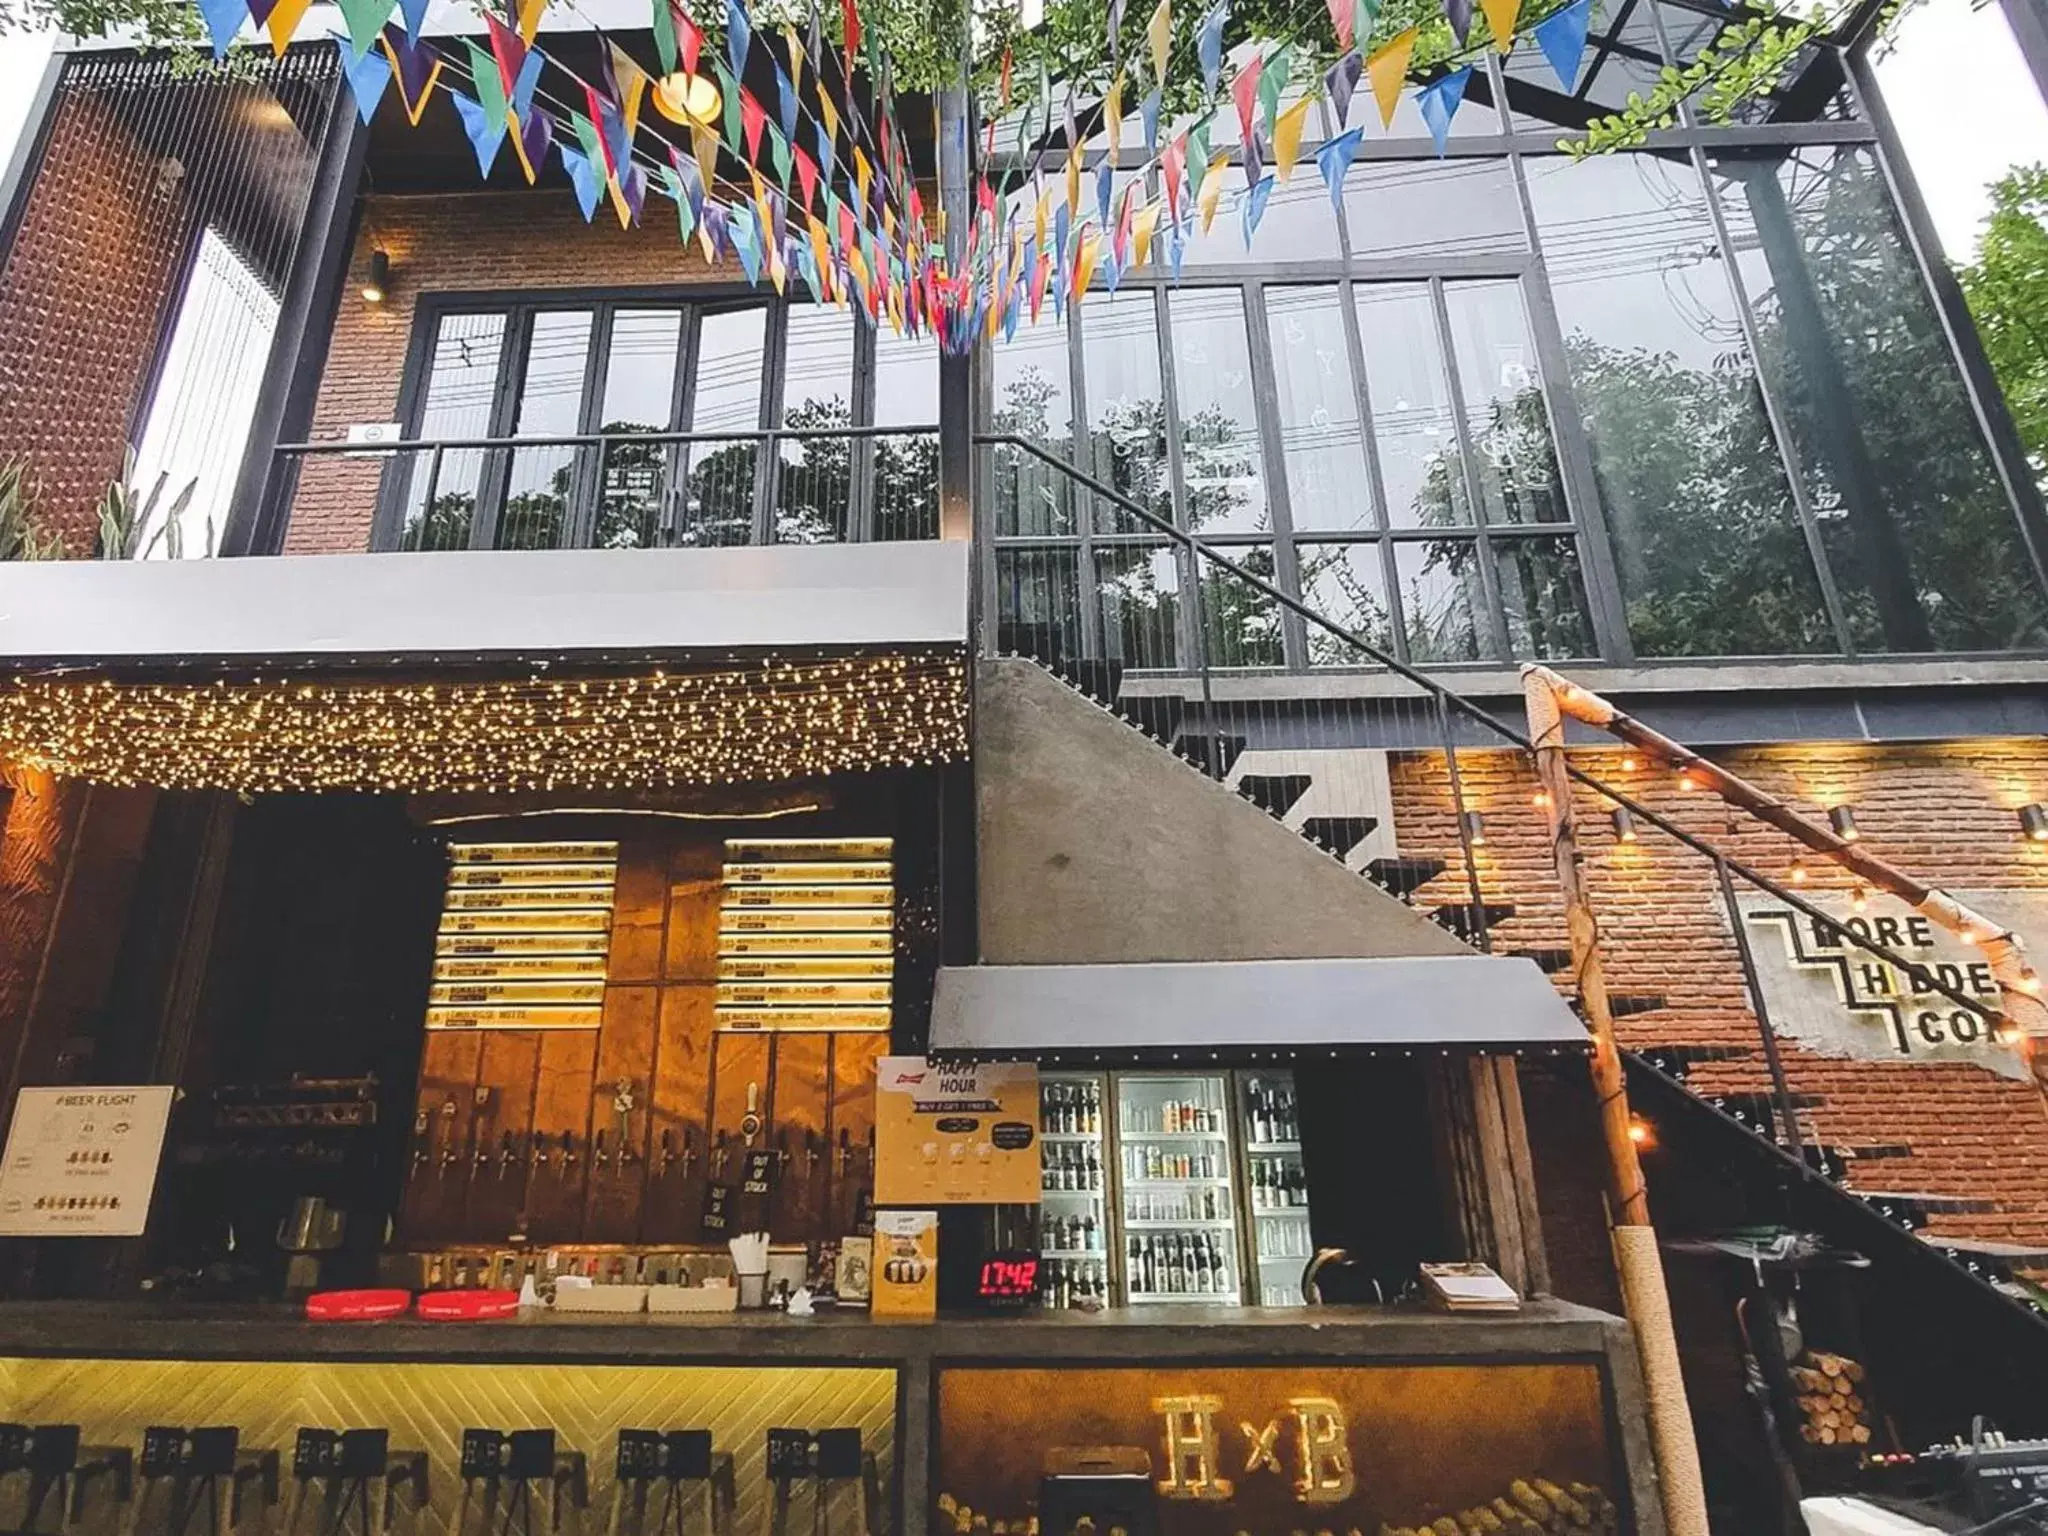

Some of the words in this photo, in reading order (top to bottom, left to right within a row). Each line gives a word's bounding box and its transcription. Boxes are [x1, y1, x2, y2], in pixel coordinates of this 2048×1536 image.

[937, 1063, 977, 1075] HAPPY
[940, 1079, 975, 1092] HOUR
[744, 1181, 767, 1192] STOCK
